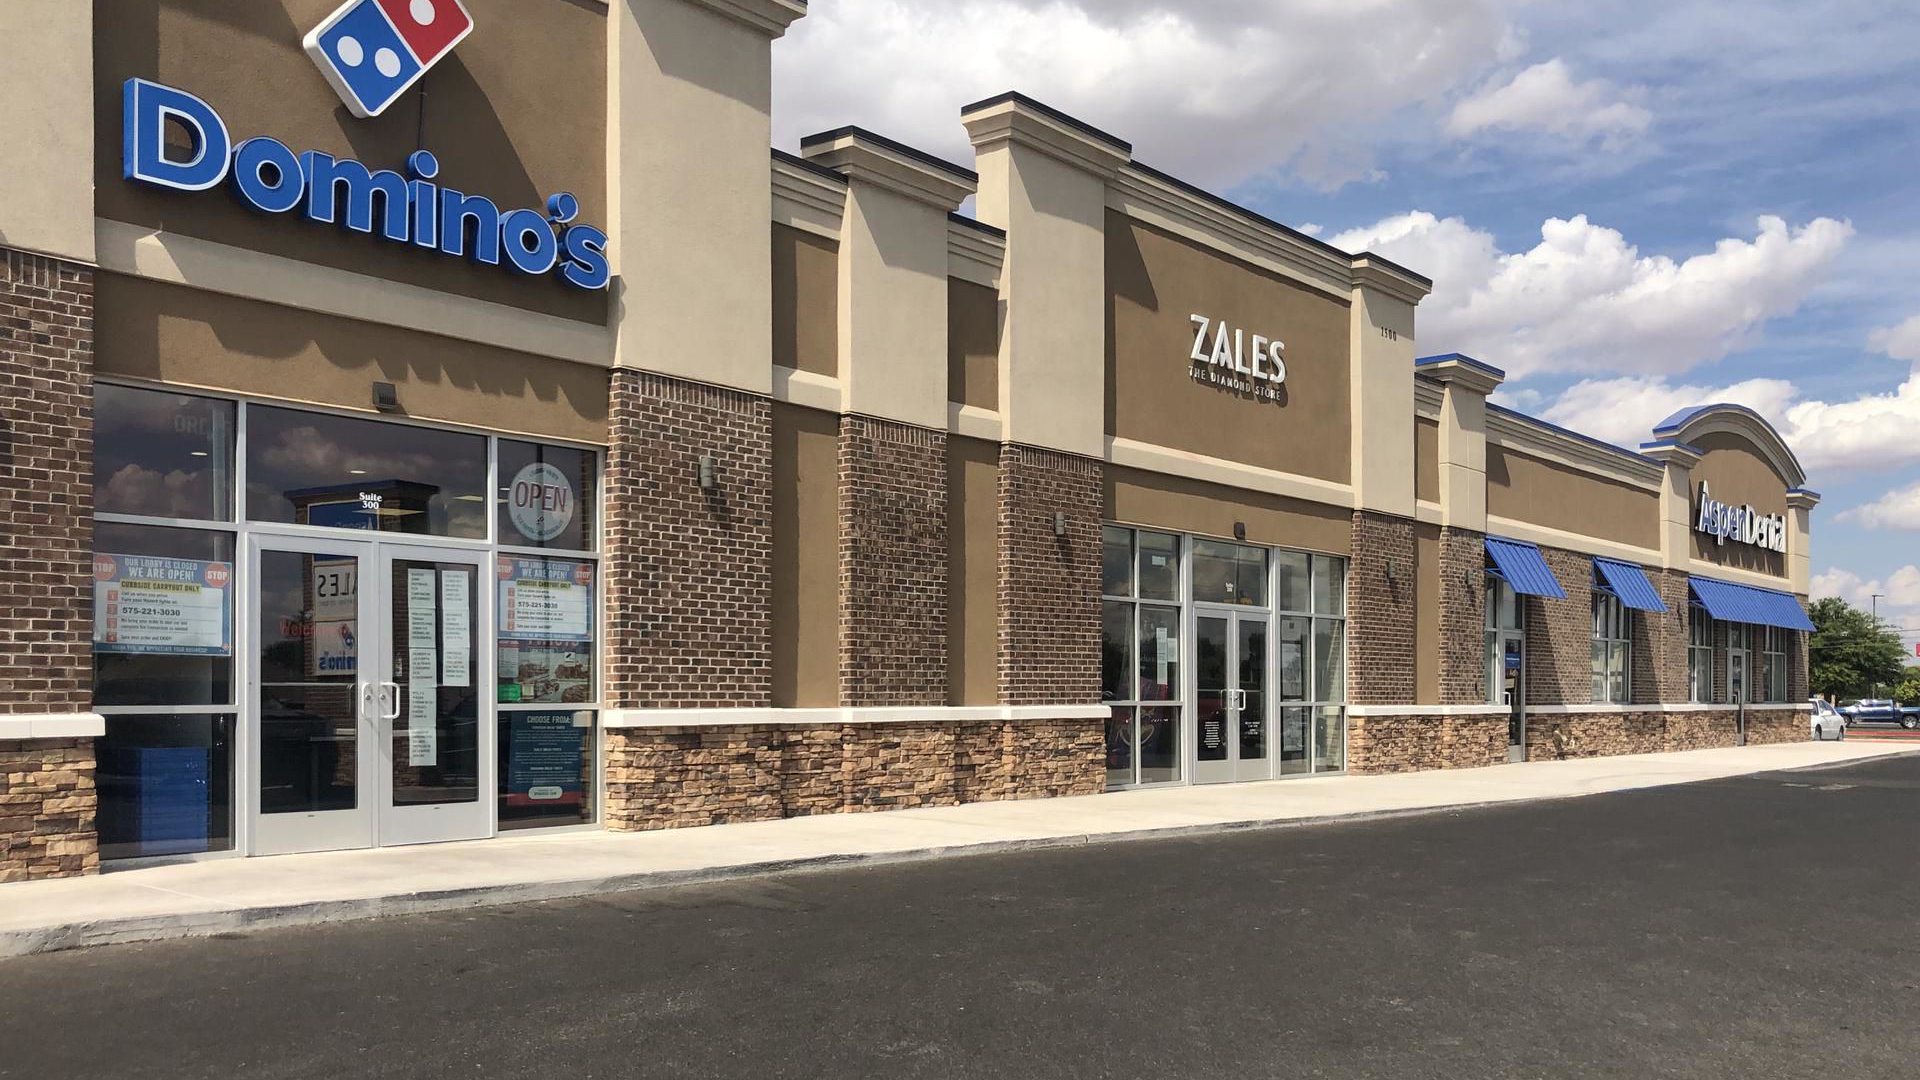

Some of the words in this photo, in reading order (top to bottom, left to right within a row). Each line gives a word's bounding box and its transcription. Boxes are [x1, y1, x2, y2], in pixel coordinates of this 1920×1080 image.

[123, 77, 612, 291] Domino's
[1380, 326, 1397, 342] 1500
[1190, 314, 1285, 384] ZALES
[1188, 365, 1206, 381] THE
[1210, 371, 1250, 394] DIAMOND
[1255, 385, 1281, 401] STORE
[359, 491, 383, 502] Suite
[515, 480, 568, 513] OPEN
[362, 500, 379, 510] 300
[129, 567, 144, 578] WE
[146, 568, 166, 579] ARE
[167, 569, 195, 581] OPEN!
[207, 570, 229, 581] STOP
[122, 607, 181, 616] 575-221-3030
[527, 715, 551, 724] CHOOSE
